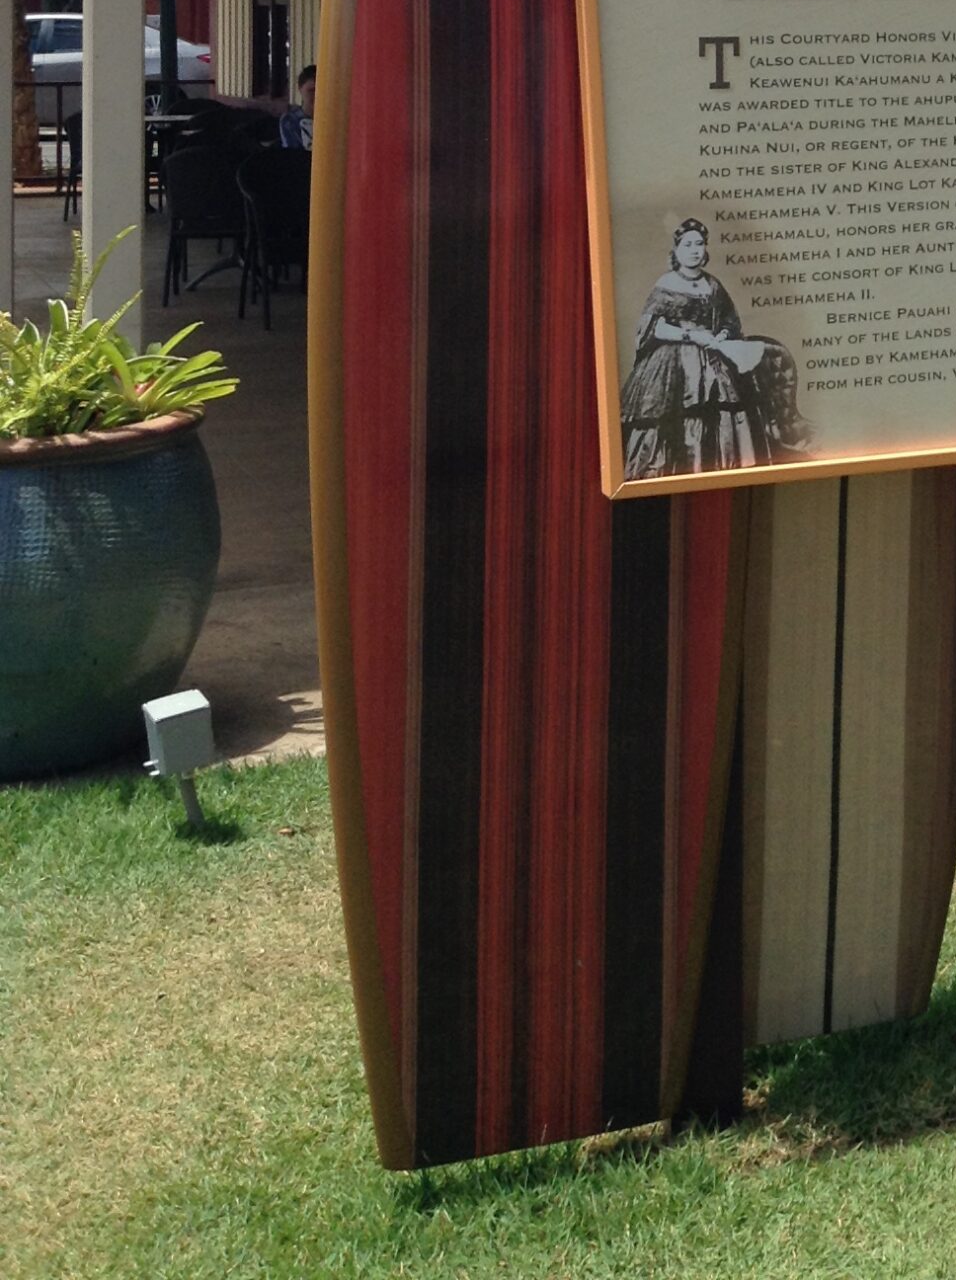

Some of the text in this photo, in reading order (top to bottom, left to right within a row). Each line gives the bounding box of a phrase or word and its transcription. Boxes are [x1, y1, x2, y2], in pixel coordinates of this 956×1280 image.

[779, 32, 871, 45] COURTYARD
[875, 31, 937, 44] HONORS
[749, 55, 794, 69] (ALSO
[798, 55, 856, 66] CALLED
[859, 53, 927, 65] VICTORIA
[749, 76, 829, 89] KEAWENUI
[935, 74, 945, 84] A
[698, 101, 732, 112] WAS
[736, 98, 810, 111] AWARDED
[813, 97, 854, 109] TITLE
[858, 96, 878, 108] TO
[881, 95, 910, 107] THE
[698, 123, 731, 135] AND
[808, 118, 866, 131] DURING
[870, 117, 899, 129] THE
[699, 144, 761, 157] KUHINA
[765, 141, 800, 154] NUI,
[804, 141, 826, 152] OR
[830, 138, 892, 152] REGENT,
[896, 137, 916, 149] OF
[919, 136, 948, 148] THE
[698, 167, 731, 179] AND
[735, 165, 766, 177] THE
[770, 163, 823, 176] SISTER
[827, 162, 847, 173] OF
[851, 159, 889, 172] KING
[699, 185, 806, 201] KAMEHAMEHA
[811, 183, 828, 195] IV
[831, 182, 863, 194] AND
[867, 180, 904, 193] KING
[908, 178, 937, 191] LOT
[715, 206, 821, 222] KAMEHAMEHA
[825, 203, 841, 216] V.
[845, 202, 882, 215] THIS
[886, 199, 950, 213] VERSION
[720, 227, 831, 244] KAMEHAMALU,
[836, 223, 897, 237] HONORS
[901, 221, 931, 234] HER
[725, 249, 832, 266] KAMEHAMEHA
[836, 247, 841, 259] I
[845, 246, 877, 258] AND
[881, 244, 911, 256] HER
[915, 241, 956, 254] AUNT
[740, 274, 773, 287] WAS
[777, 272, 807, 284] THE
[811, 267, 880, 282] CONSORT
[884, 266, 904, 277] OF
[908, 263, 945, 276] KING
[751, 288, 875, 308] KAMEHAMEHA II.
[826, 310, 892, 325] BERNICE
[897, 305, 951, 319] PAUAHI
[801, 335, 843, 349] MANY
[847, 333, 867, 345] OF
[871, 330, 900, 343] THE
[905, 327, 952, 341] LANDS
[805, 355, 861, 370] OWNED
[865, 353, 884, 365] BY
[806, 378, 848, 392] FROM
[853, 375, 883, 388] HER
[887, 370, 947, 385] COUSIN,
